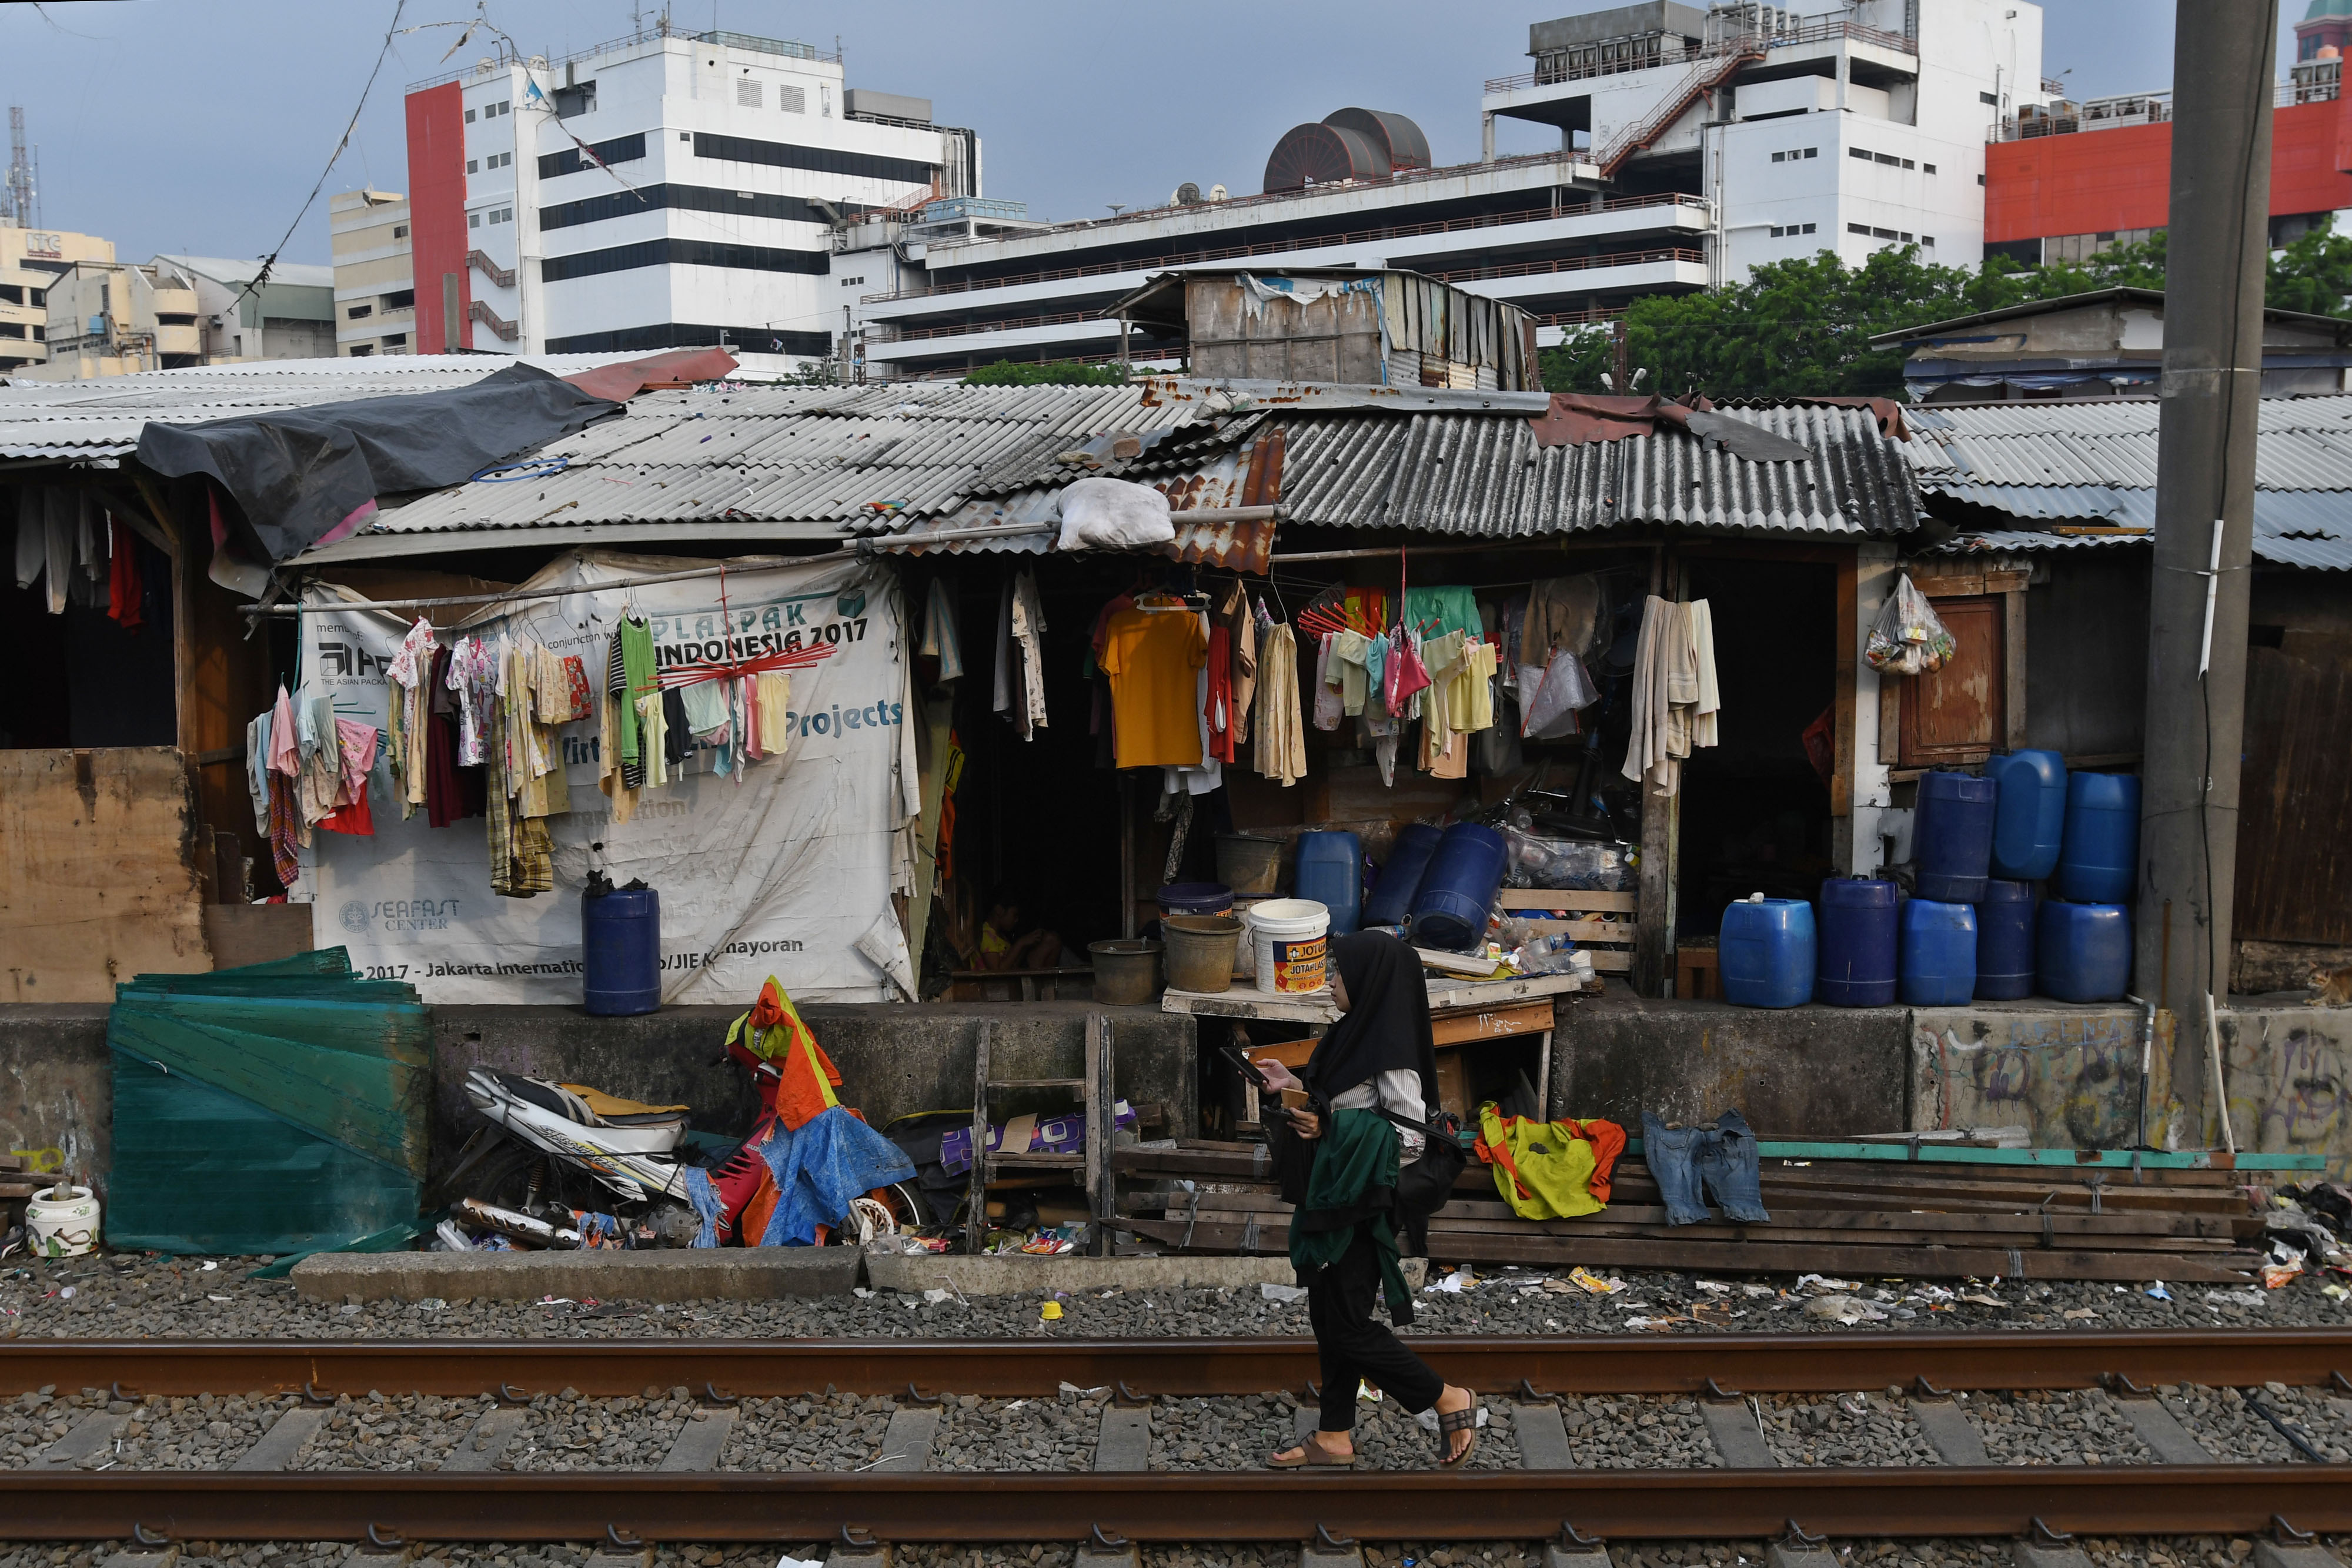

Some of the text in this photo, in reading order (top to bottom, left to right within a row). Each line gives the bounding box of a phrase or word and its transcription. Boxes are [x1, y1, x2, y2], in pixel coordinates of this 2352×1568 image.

[26, 233, 61, 252] ITC
[651, 603, 807, 642] PLASPAK
[654, 618, 868, 666] INDONESIA 2017
[786, 699, 903, 740] Projects
[371, 899, 459, 918] SEAFAST
[385, 918, 448, 931] CENTER
[366, 964, 409, 981] 2017
[426, 961, 492, 978] Jakarta
[746, 1144, 759, 1152] SUZ
